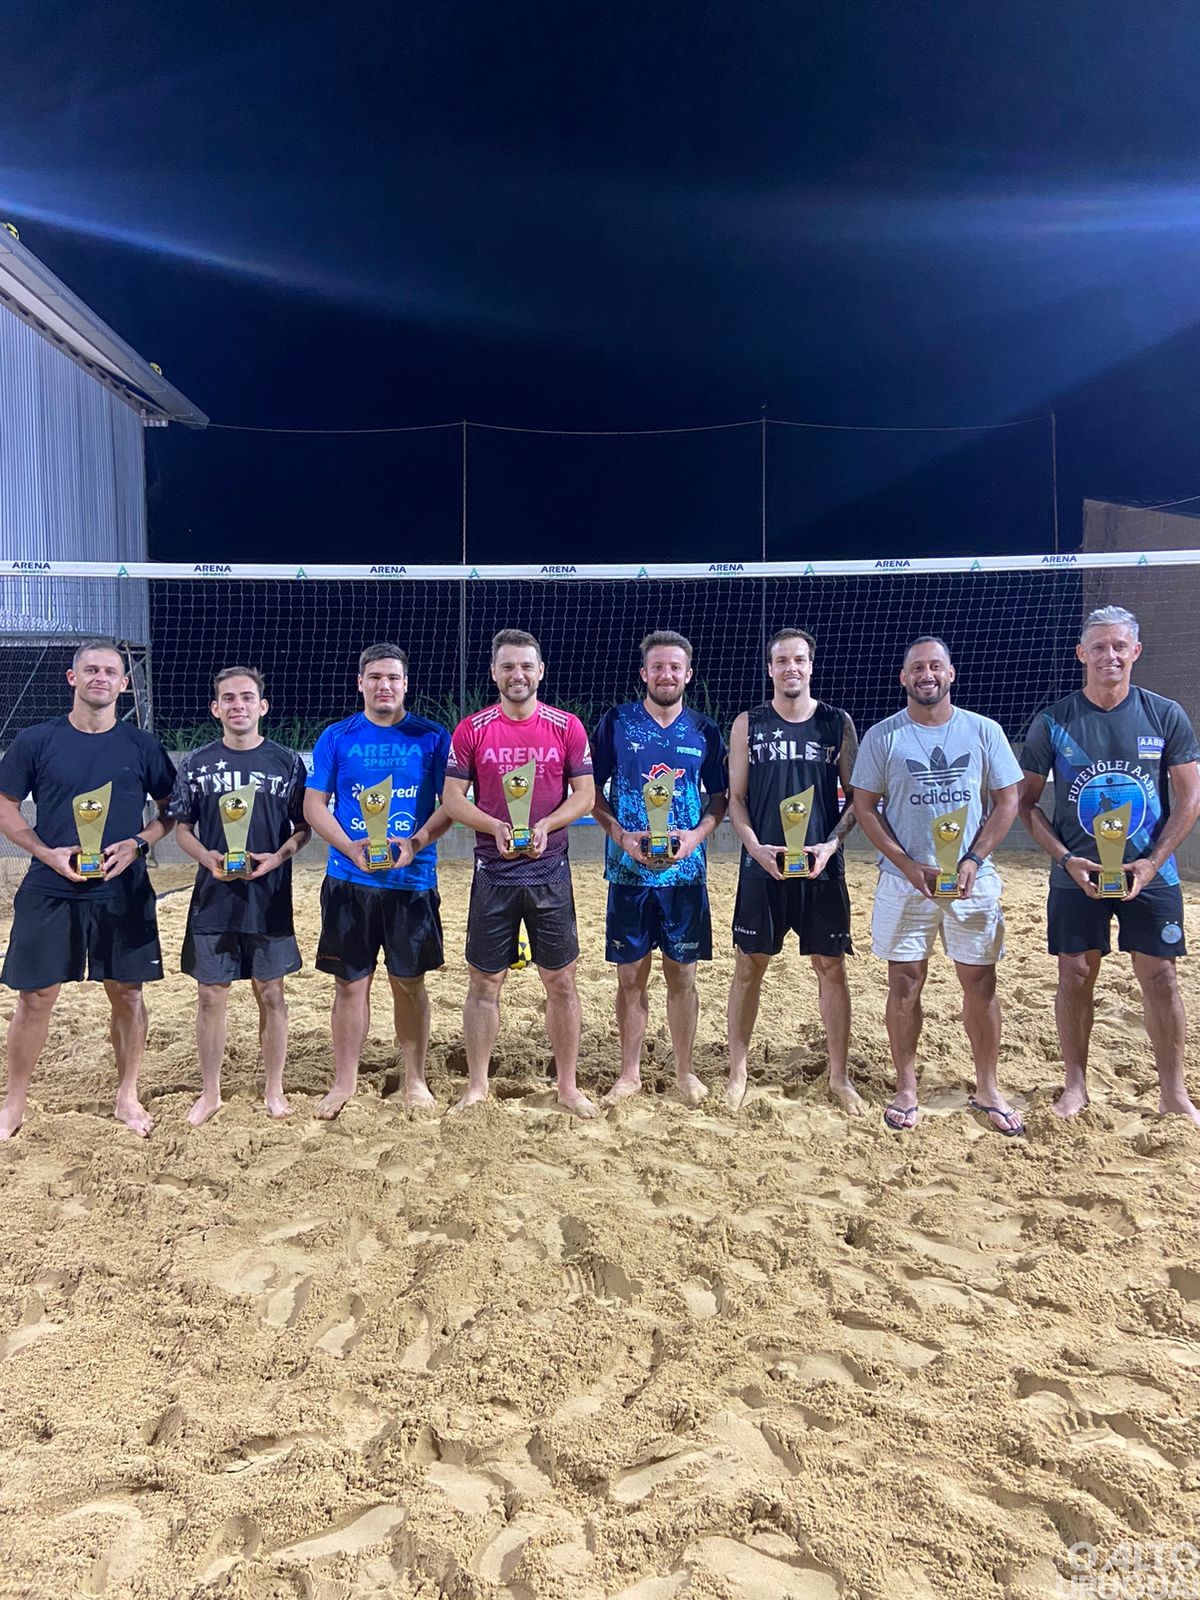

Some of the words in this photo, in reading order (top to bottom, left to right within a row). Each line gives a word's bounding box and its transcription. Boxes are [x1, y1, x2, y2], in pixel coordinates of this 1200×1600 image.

[875, 559, 911, 568] ARENA
[1041, 555, 1078, 563] ARENA
[12, 561, 51, 570] ARENA
[194, 564, 232, 573] ARENA
[370, 566, 407, 574] ARENA
[709, 563, 744, 572] ARENA
[347, 743, 423, 758] ARENA
[481, 747, 560, 764] ARENA
[363, 757, 408, 768] SPORTS
[1068, 760, 1130, 804] FUTEVÔLEI
[910, 788, 972, 806] adidas
[394, 820, 411, 831] RS
